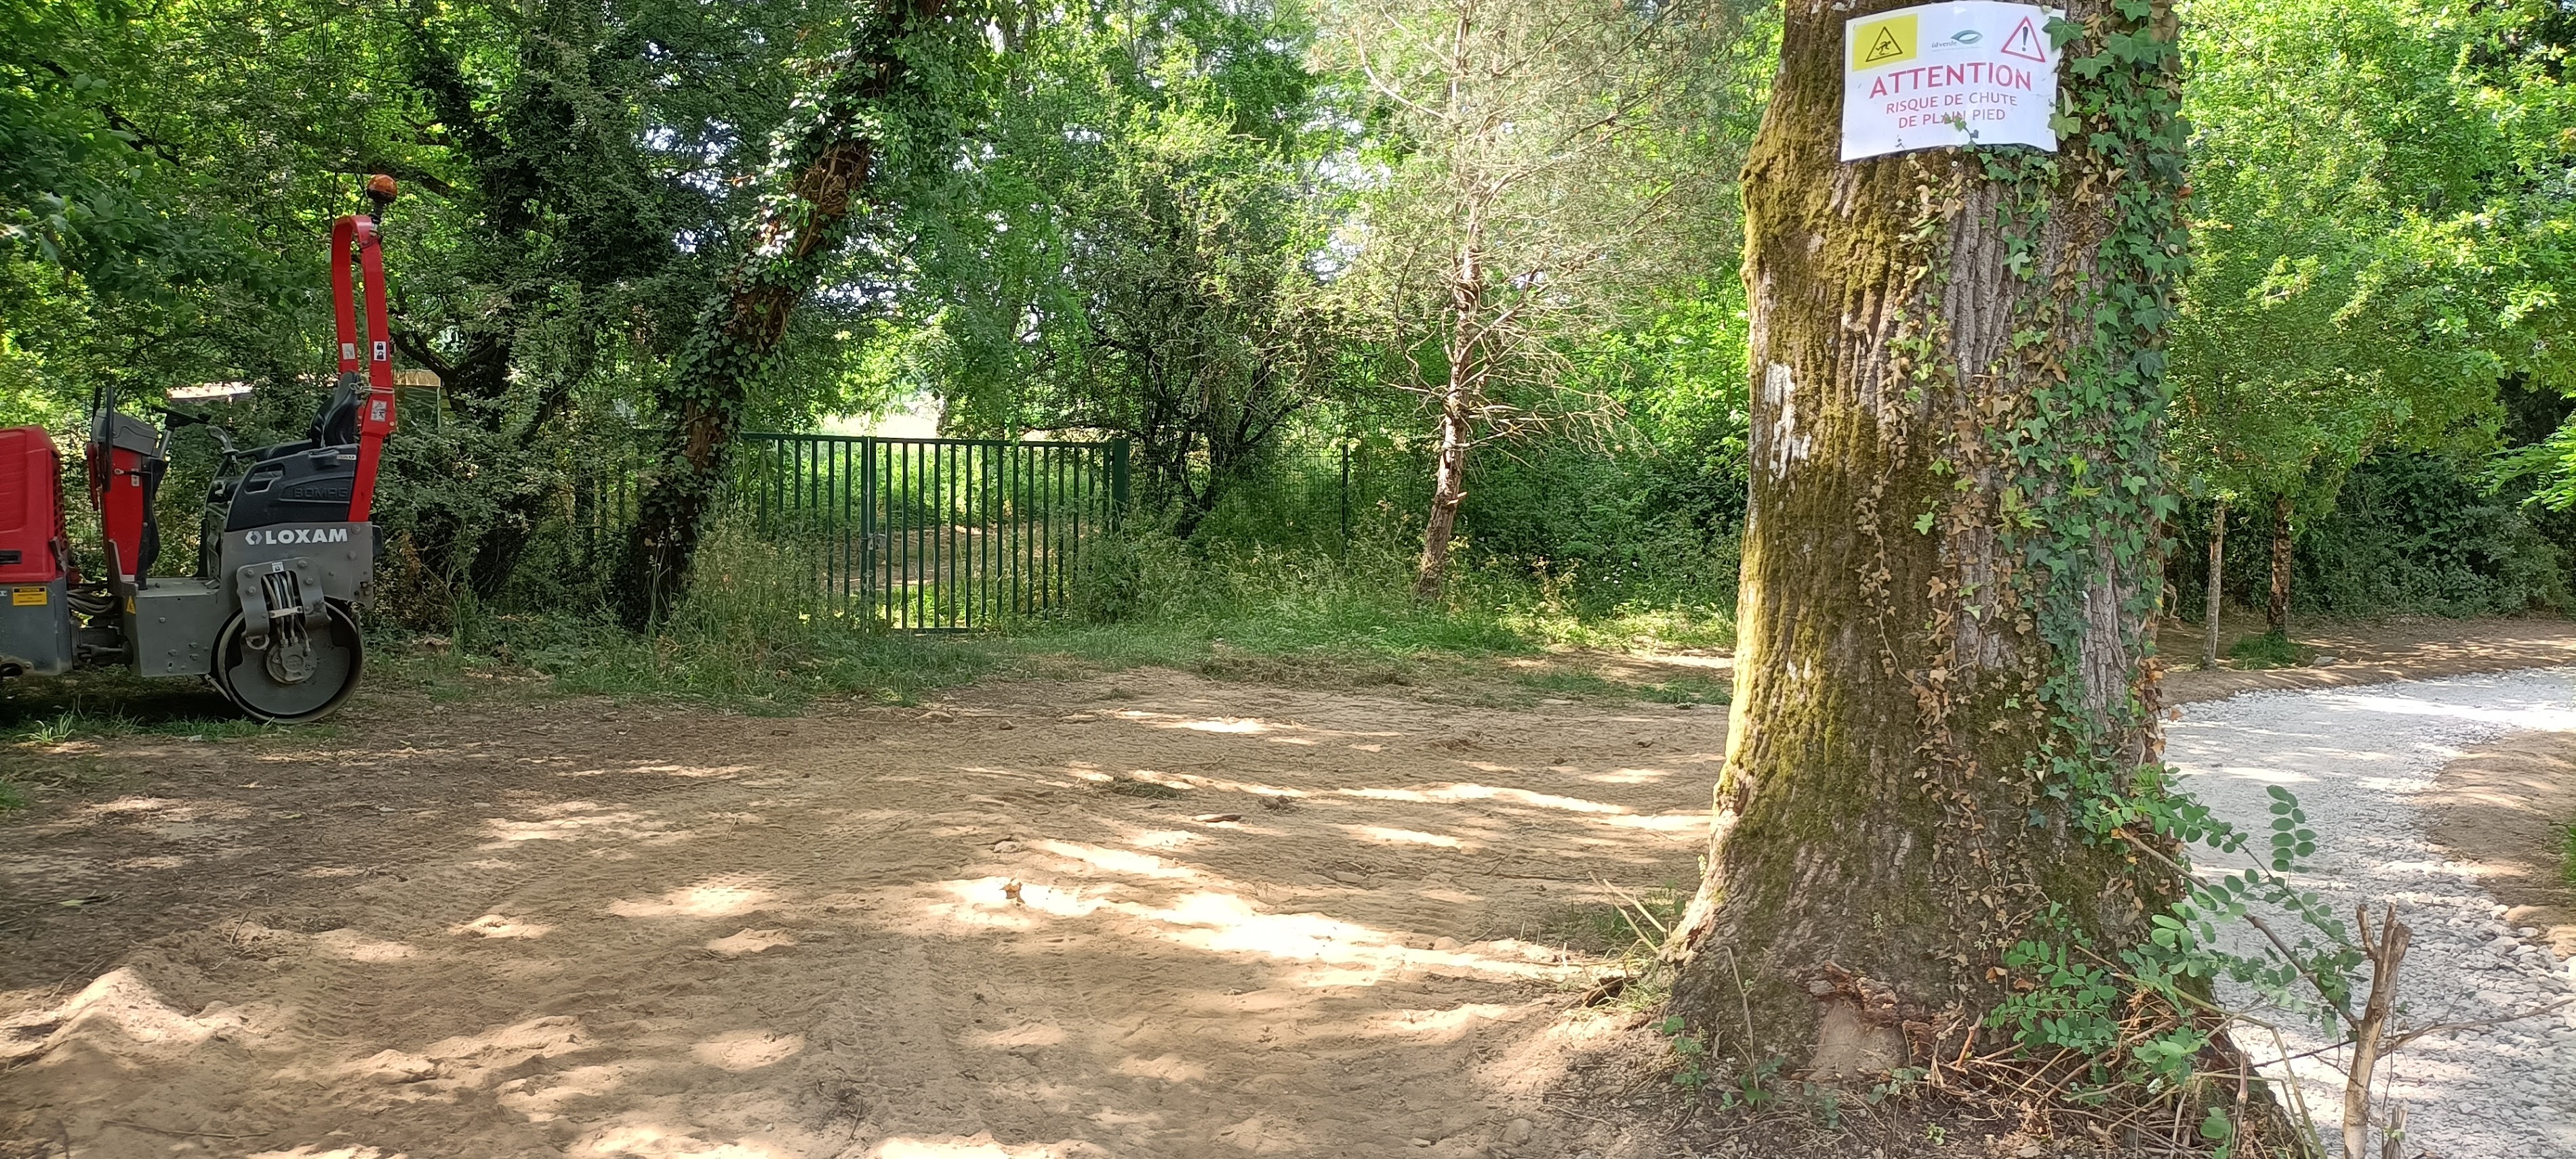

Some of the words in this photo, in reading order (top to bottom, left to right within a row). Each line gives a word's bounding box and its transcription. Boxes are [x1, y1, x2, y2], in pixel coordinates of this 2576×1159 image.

[1869, 62, 2032, 99] ATTENTION
[1886, 96, 1939, 115] RISQUE
[1944, 94, 1963, 106] DE
[1969, 92, 2017, 106] CHUTE
[1898, 115, 1917, 129] DE
[1972, 108, 2006, 121] PIED
[265, 528, 348, 545] LOXAM
